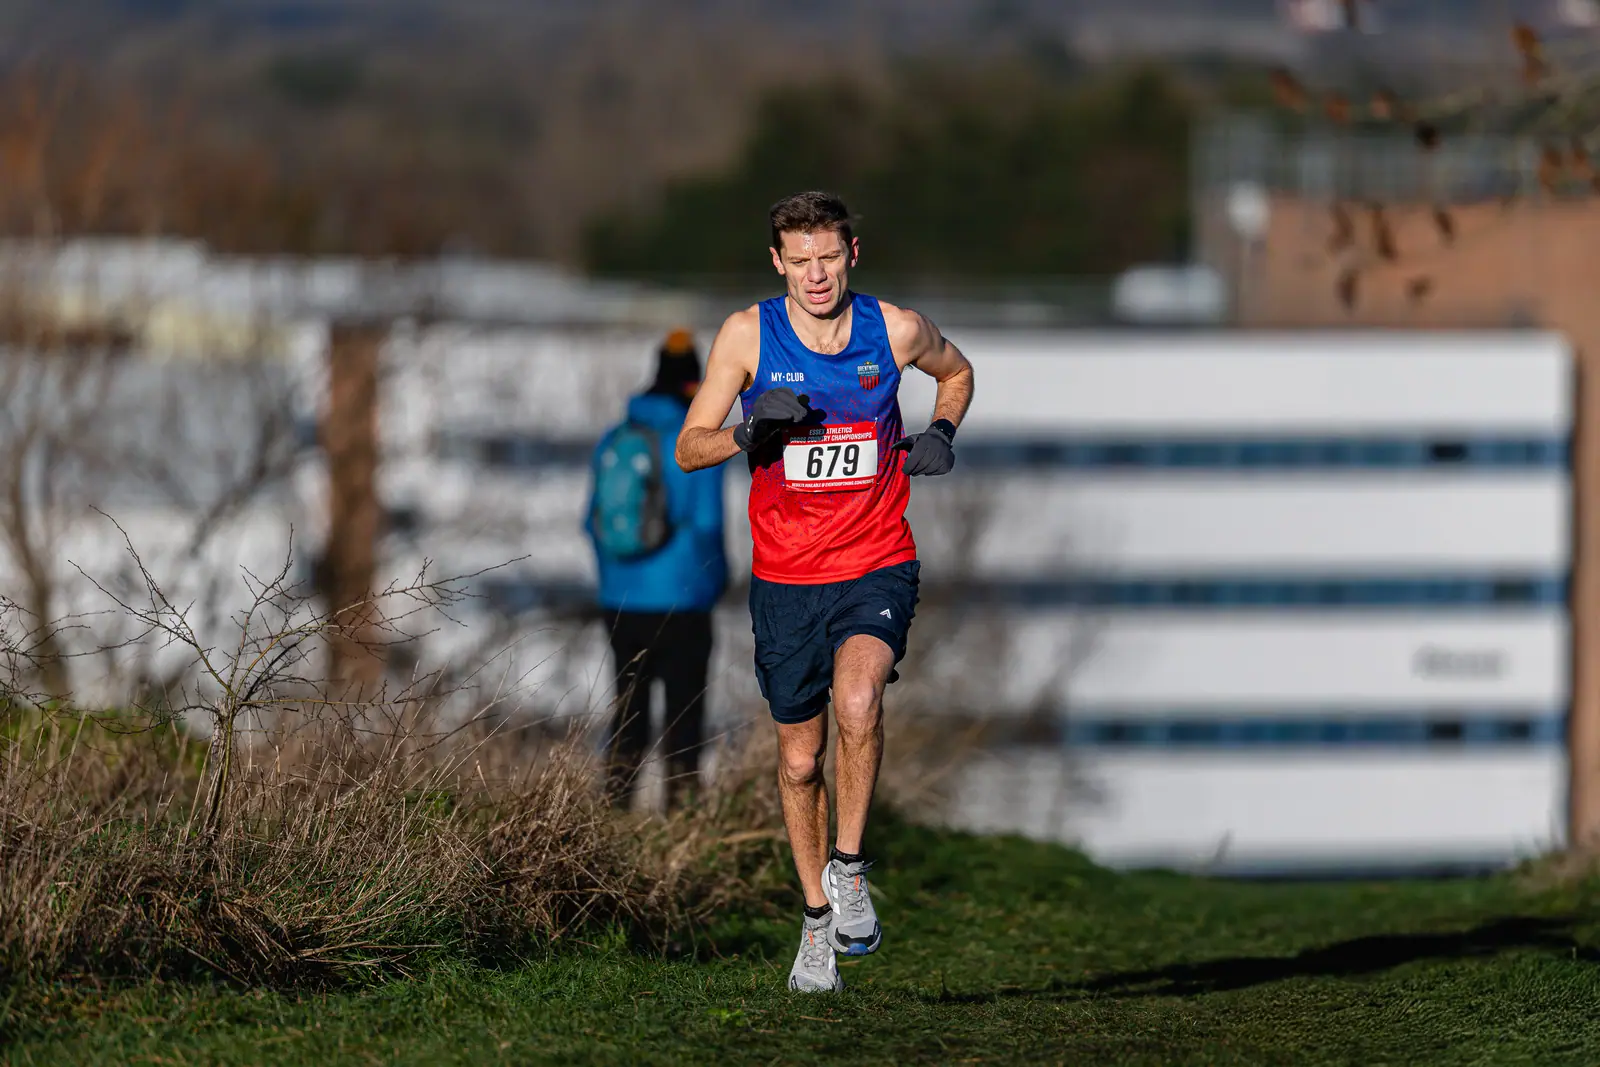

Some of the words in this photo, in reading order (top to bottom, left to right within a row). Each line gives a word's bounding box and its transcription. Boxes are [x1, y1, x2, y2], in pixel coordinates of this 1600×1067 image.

[826, 426, 853, 435] ATHLETICS
[831, 432, 873, 442] CHAMPIONSHIPS
[806, 443, 860, 479] 679
